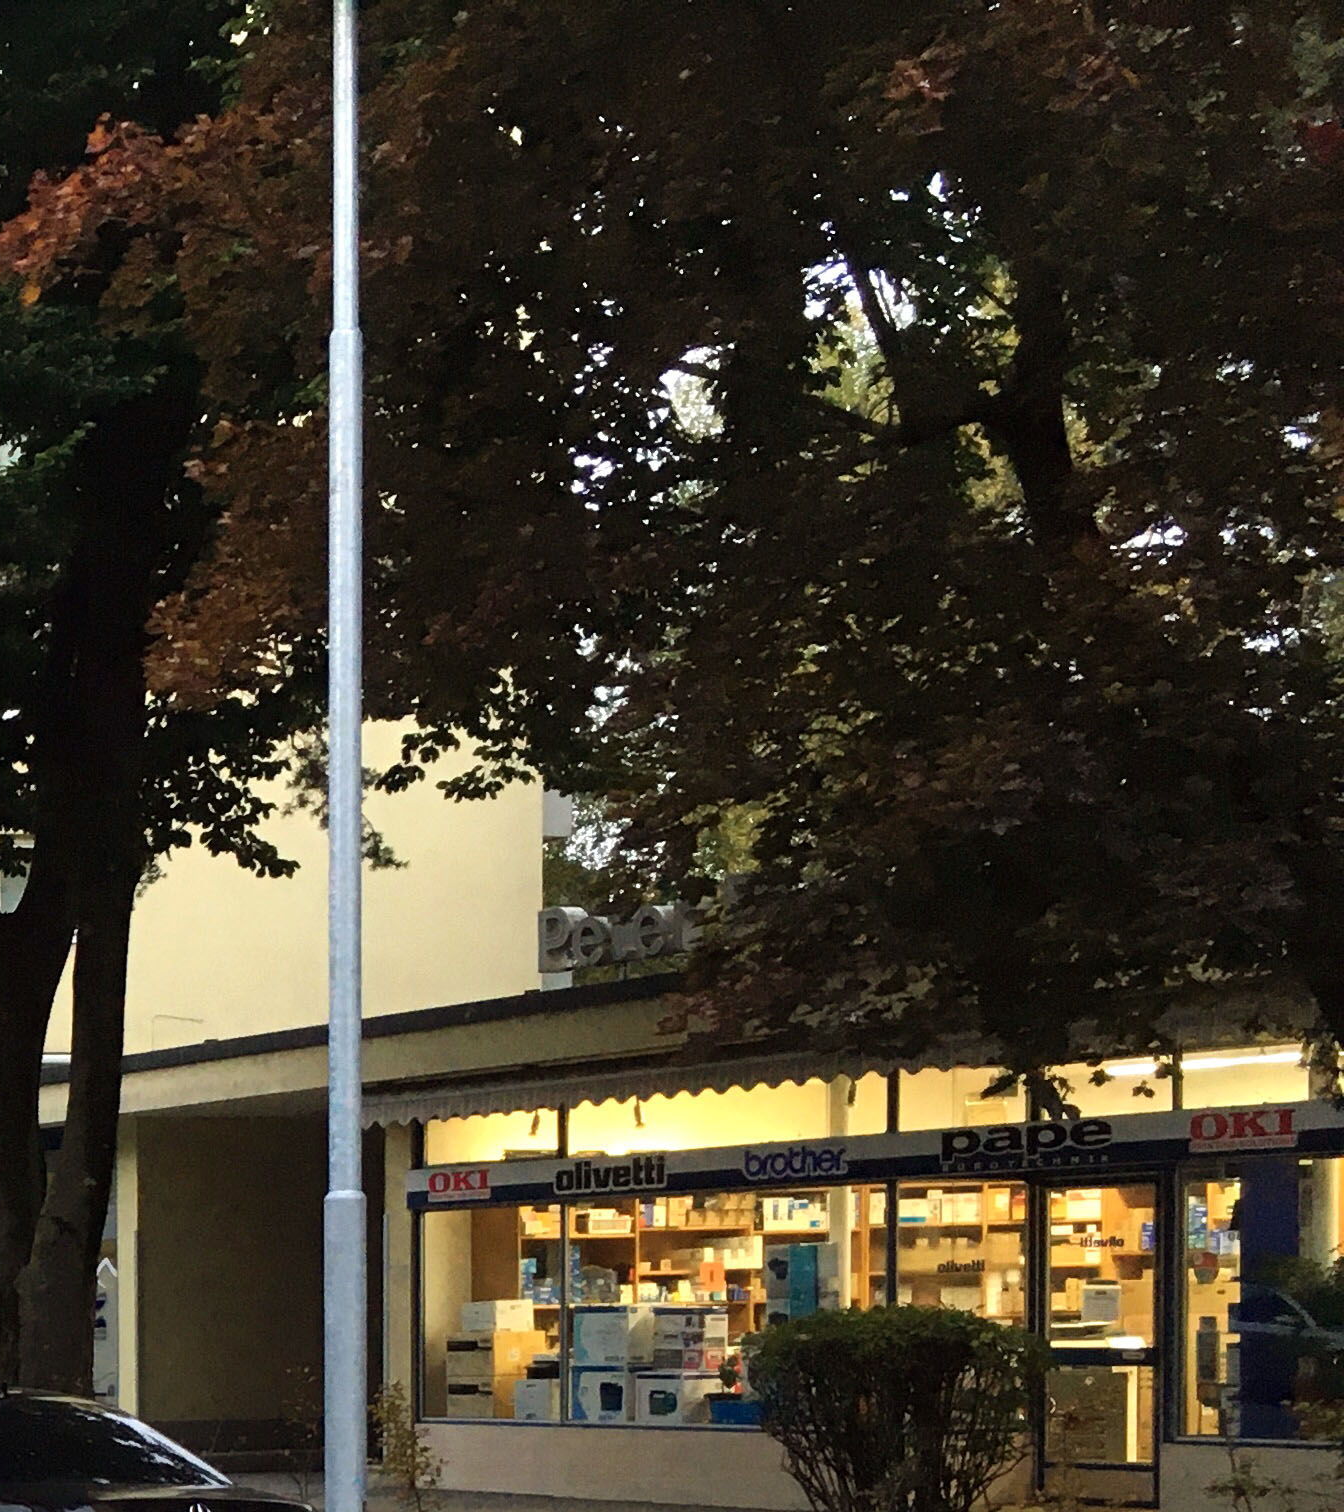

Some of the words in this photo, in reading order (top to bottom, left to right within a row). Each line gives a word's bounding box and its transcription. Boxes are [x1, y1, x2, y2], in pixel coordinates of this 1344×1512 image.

[941, 1119, 1113, 1162] pape
[1190, 1108, 1296, 1141] OKI
[555, 1154, 666, 1192] olivetti
[744, 1146, 847, 1177] brother
[427, 1168, 490, 1194] OKI
[937, 1259, 986, 1273] olivetti
